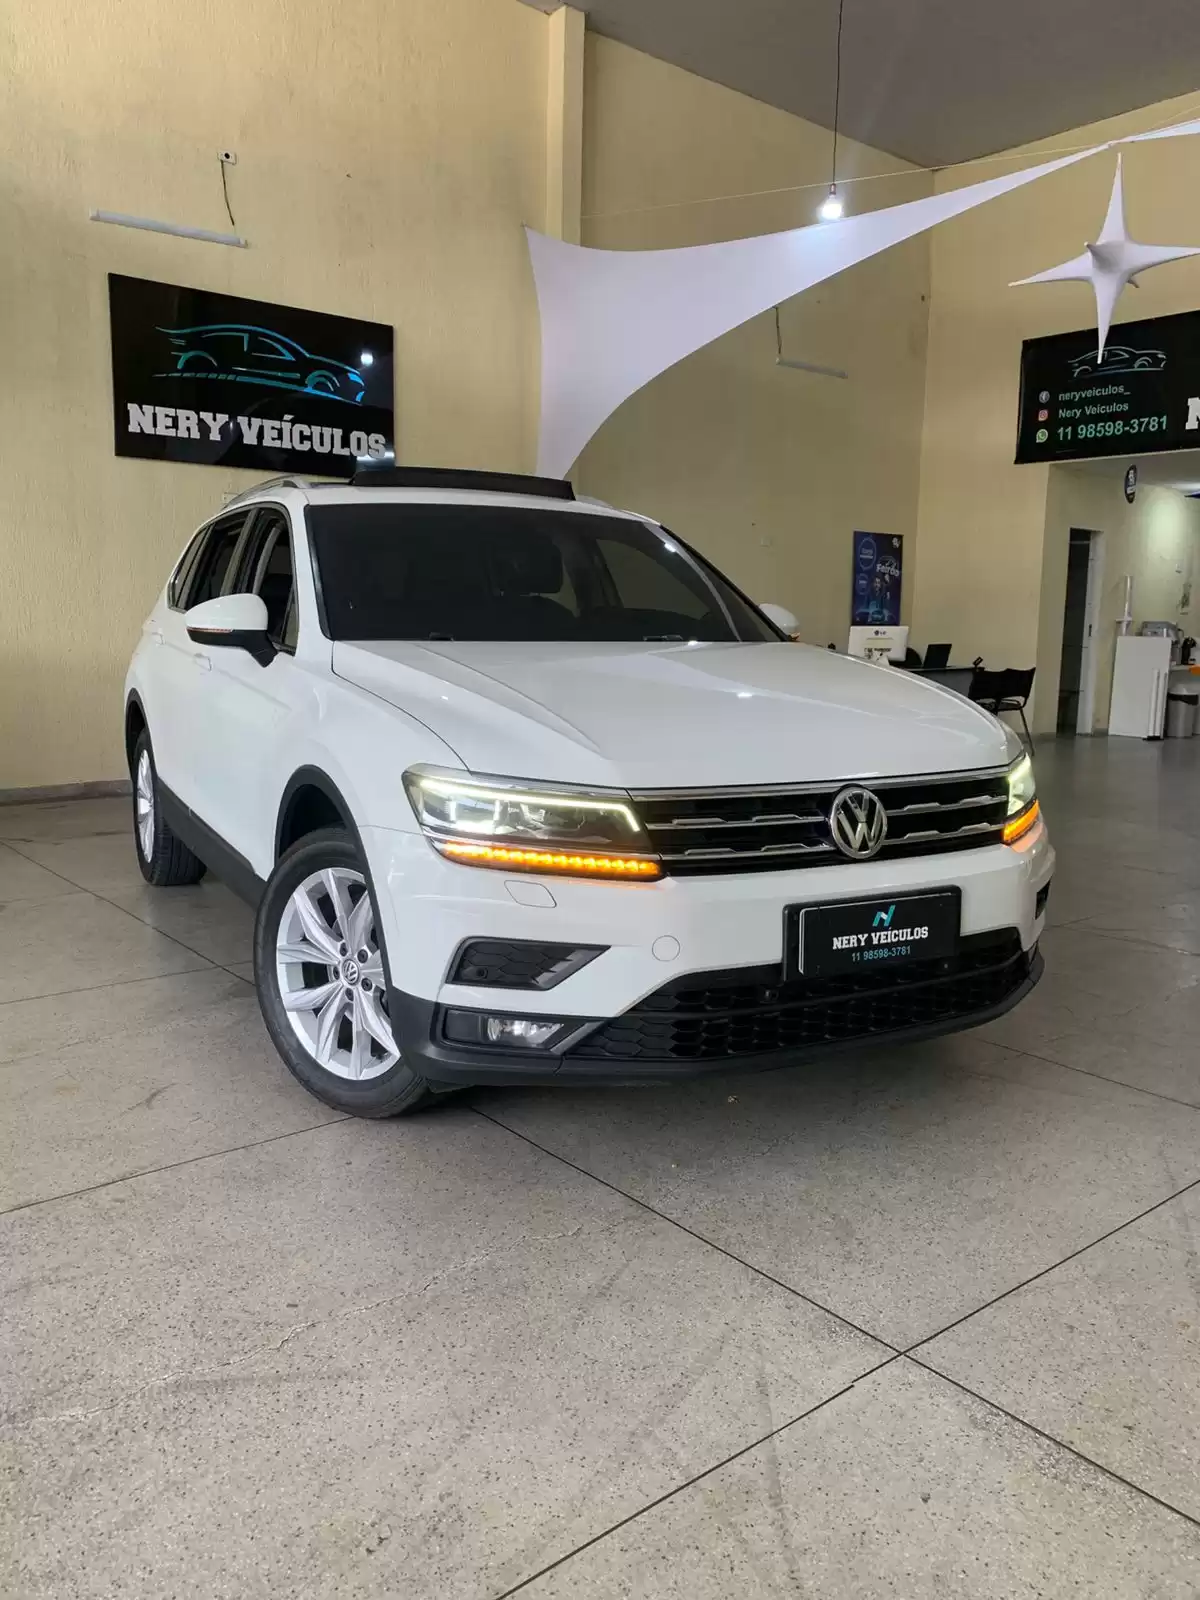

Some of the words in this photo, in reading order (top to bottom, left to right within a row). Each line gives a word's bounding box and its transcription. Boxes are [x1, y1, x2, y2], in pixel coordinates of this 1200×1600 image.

[1058, 406, 1082, 419] Nery
[127, 403, 229, 441] NERY
[237, 414, 387, 459] VEÍCULOS
[1057, 426, 1072, 441] 11
[1077, 415, 1168, 440] 98598-3781
[832, 933, 869, 949] NERY
[870, 927, 929, 946] VEÍCULOS
[851, 952, 861, 962] 11
[863, 945, 911, 961] 98598-3781
